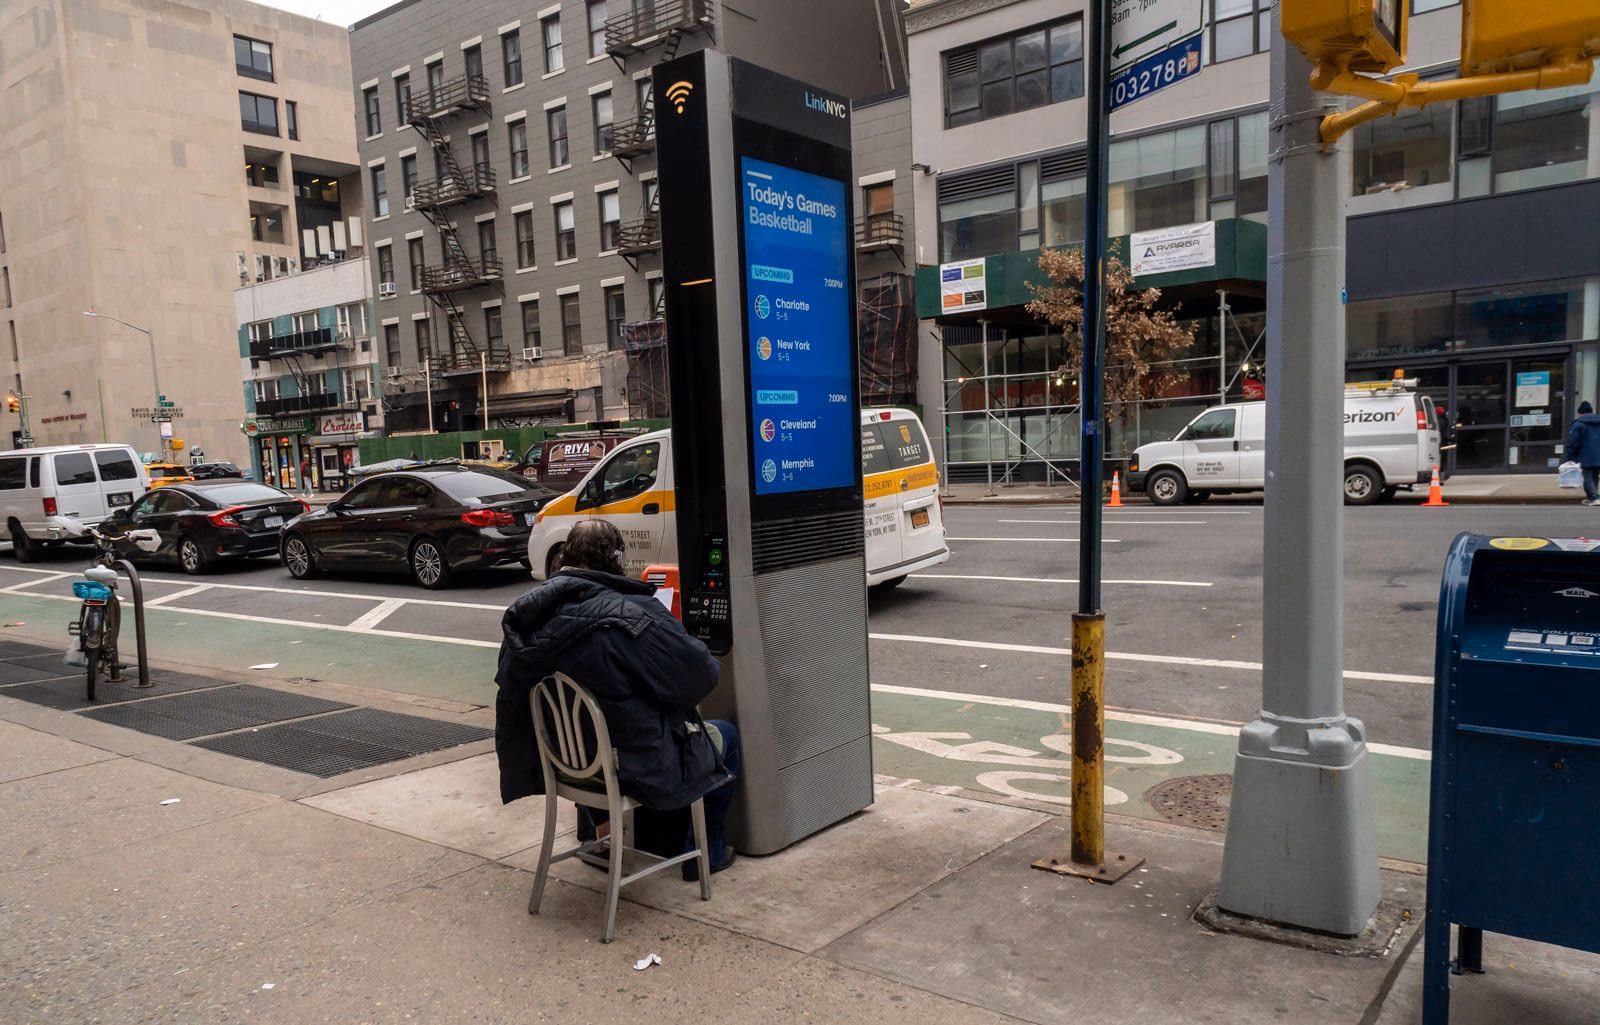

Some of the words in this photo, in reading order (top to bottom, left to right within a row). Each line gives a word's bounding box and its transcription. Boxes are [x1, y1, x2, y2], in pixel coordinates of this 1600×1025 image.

[1112, 8, 1130, 25] 8am
[805, 91, 846, 119] LinkNYC
[747, 182, 794, 211] Today's
[796, 194, 837, 218] Games
[749, 206, 813, 235] Basketball
[1156, 240, 1201, 251] AVARGA
[754, 268, 791, 281] UPCOMING
[824, 278, 844, 289] 7:00PM
[775, 298, 810, 311] Charlotte
[776, 312, 788, 320] 5-5
[777, 339, 794, 350] New
[795, 340, 811, 351] York
[778, 353, 790, 361] 5-5
[760, 393, 795, 402] UPCOMING
[828, 394, 848, 403] 7:00PM
[1344, 410, 1396, 423] erizon
[323, 418, 363, 432] Erotica
[780, 420, 816, 430] Cleveland
[781, 433, 793, 441] 5-5
[564, 443, 590, 454] RIYA
[898, 444, 921, 457] TARGET
[781, 459, 814, 471] Memphis
[782, 473, 793, 481] 3-6
[631, 530, 650, 539] STREET
[638, 541, 652, 549] 10001
[1542, 629, 1600, 637] COLLECTIO
